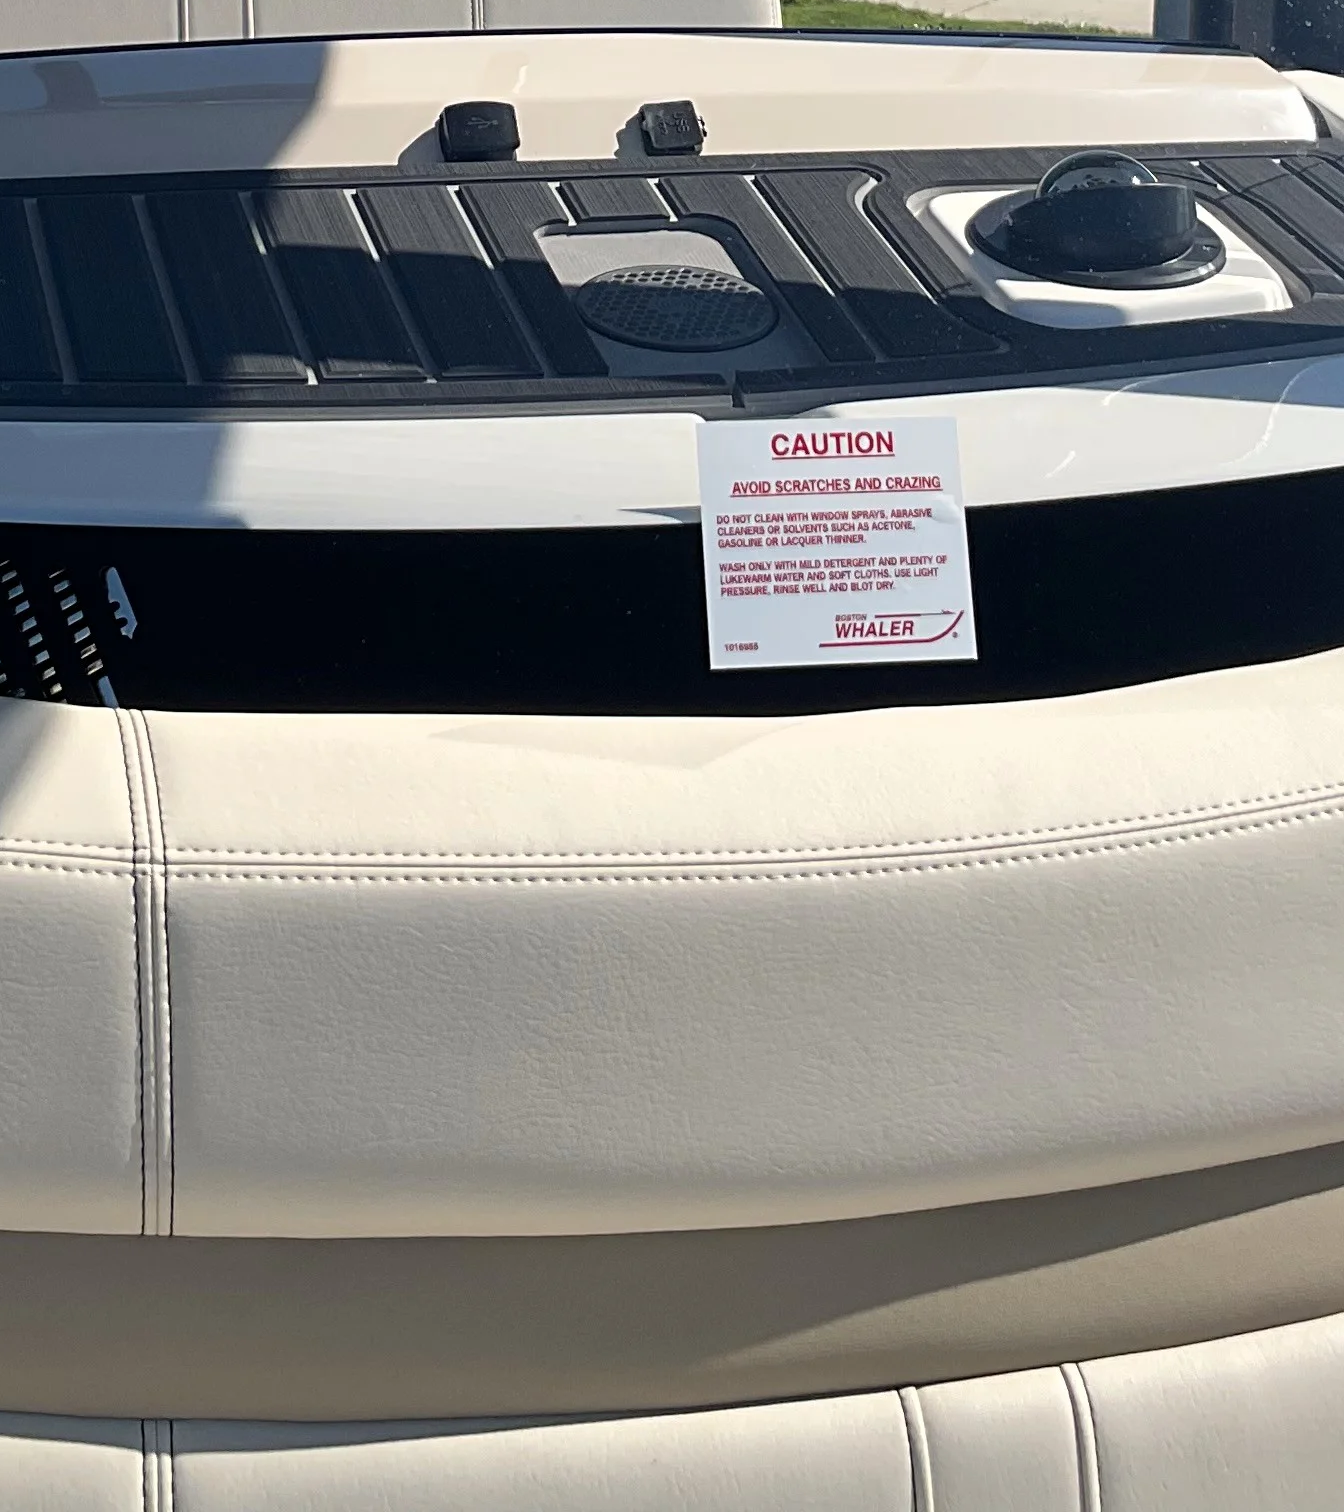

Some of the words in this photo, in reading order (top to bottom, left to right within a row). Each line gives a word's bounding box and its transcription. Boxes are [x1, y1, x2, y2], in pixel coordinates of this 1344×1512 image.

[771, 431, 894, 456] CAUTION
[732, 481, 771, 494] AVOID
[775, 478, 851, 493] SCRATCHES
[855, 477, 882, 490] AND
[885, 475, 941, 489] CRAZING
[716, 515, 730, 524] DO
[732, 514, 751, 524] NOT
[754, 513, 784, 523] CLEAN
[786, 512, 809, 522] WITH
[811, 510, 849, 521] WINDOW
[890, 508, 933, 518] ABRASIVE
[717, 526, 765, 536] CLEANERS
[767, 525, 781, 535] OR
[783, 523, 829, 534] SOLVENTS
[831, 522, 855, 532] SUCH
[857, 521, 870, 532] AS
[718, 537, 763, 548] GASOLINE
[765, 536, 779, 546] OR
[781, 535, 824, 547] LACQUER
[719, 562, 746, 572] WASH
[748, 561, 772, 571] ONLY
[774, 559, 797, 570] WITH
[799, 559, 822, 569] MILD
[824, 557, 876, 568] DETERGENT
[878, 556, 898, 566] AND
[899, 555, 934, 565] PLENTY
[936, 554, 948, 564] OF
[720, 573, 772, 585] LUKEWARM
[774, 572, 805, 583] WATER
[807, 571, 827, 581] AND
[828, 570, 852, 580] SOFT
[894, 568, 912, 578] USE
[913, 566, 939, 577] LIGHT
[773, 584, 801, 595] RINSE
[802, 583, 827, 594] WELL
[829, 582, 849, 593] AND
[850, 581, 873, 591] BLOT
[835, 614, 868, 622] BOSTON
[836, 620, 915, 639] WHALER
